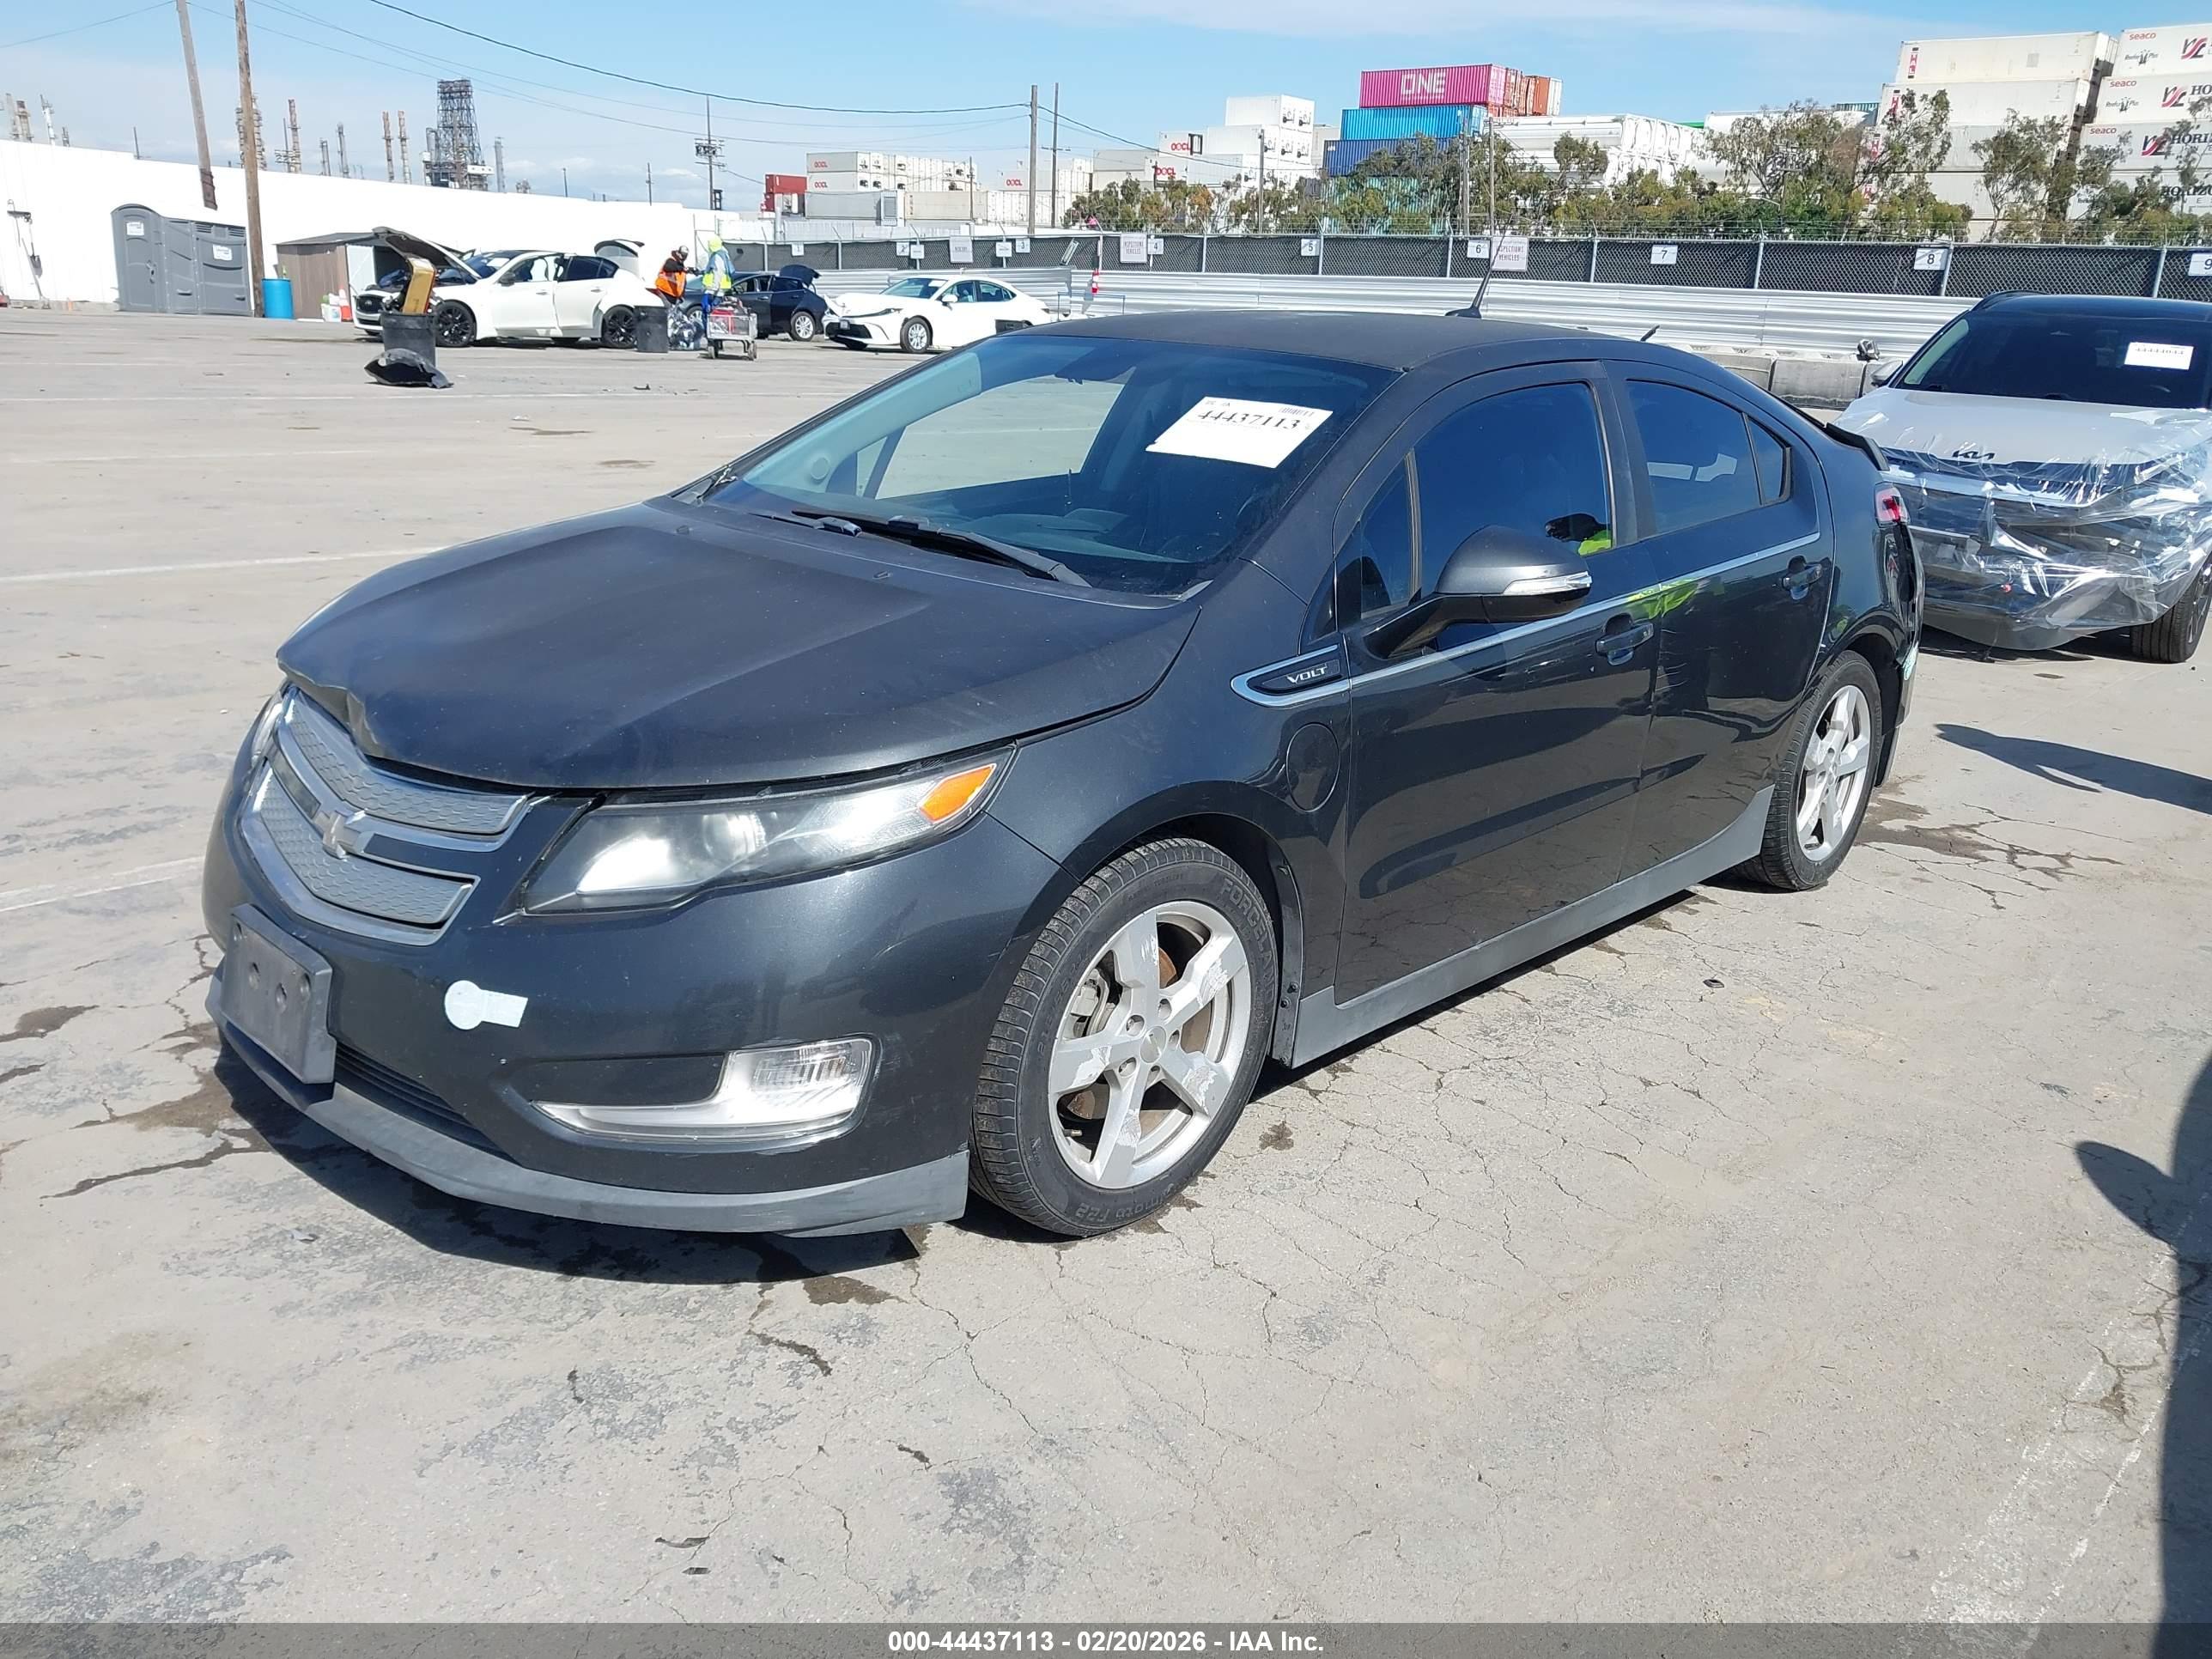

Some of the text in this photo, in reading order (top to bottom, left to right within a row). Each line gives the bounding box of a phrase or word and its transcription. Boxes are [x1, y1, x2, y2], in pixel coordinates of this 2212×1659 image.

[2129, 33, 2157, 41] seaco
[1401, 72, 1446, 94] ONE
[1476, 245, 1481, 253] 6
[1662, 249, 1668, 259] 7
[1927, 253, 1936, 265] 8
[1198, 410, 1301, 428] 44437113
[1287, 665, 1328, 684] VOLT
